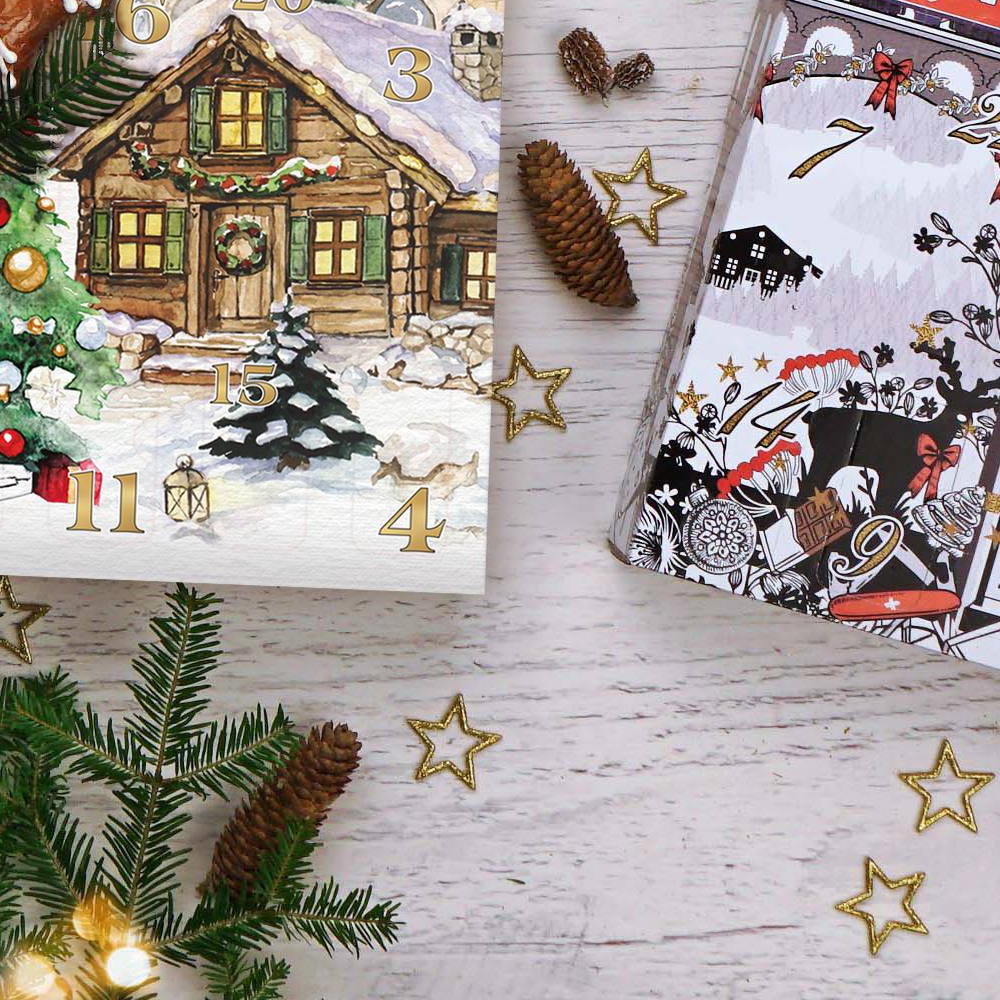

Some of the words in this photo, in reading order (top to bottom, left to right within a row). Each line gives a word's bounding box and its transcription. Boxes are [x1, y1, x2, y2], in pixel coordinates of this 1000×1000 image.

[383, 46, 433, 103] 3
[788, 118, 874, 179] 7
[947, 94, 1000, 150] 2
[211, 362, 279, 407] 15
[716, 382, 820, 448] 14
[66, 469, 145, 535] 11
[378, 486, 448, 554] 4
[832, 516, 903, 578] 9
